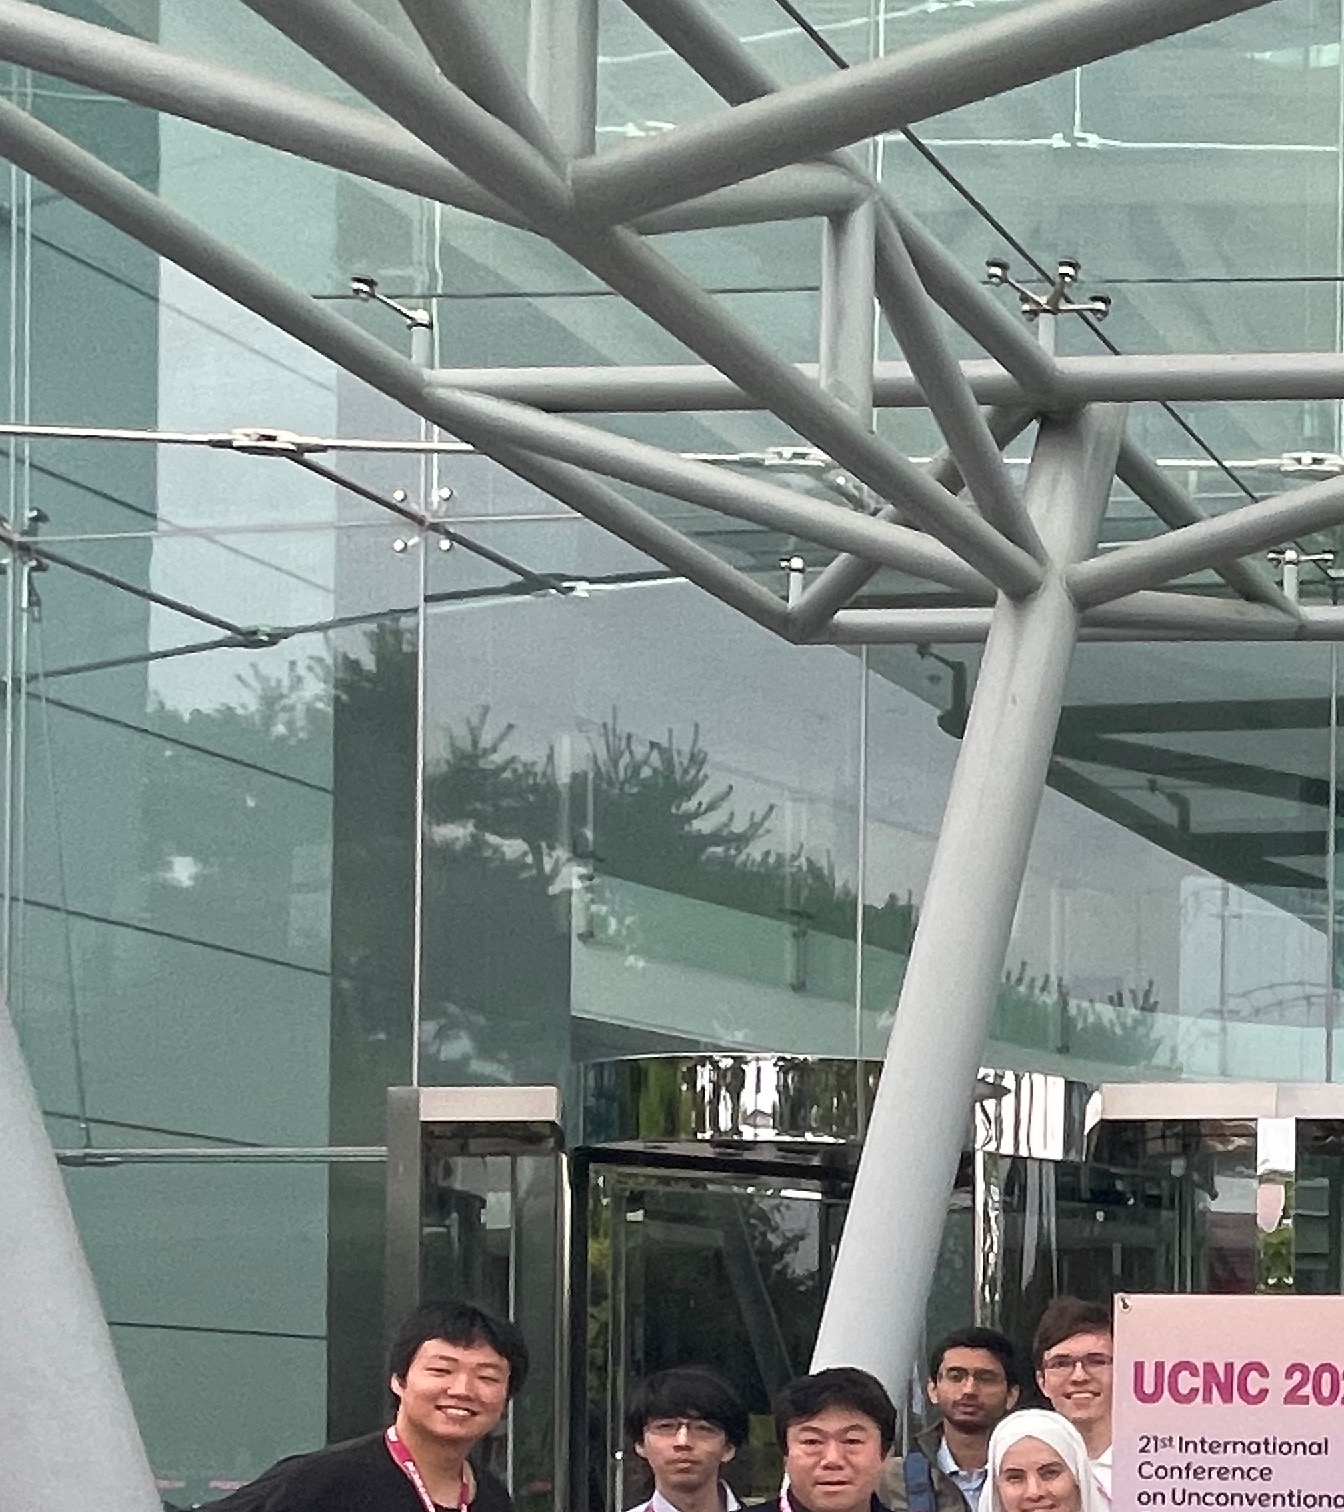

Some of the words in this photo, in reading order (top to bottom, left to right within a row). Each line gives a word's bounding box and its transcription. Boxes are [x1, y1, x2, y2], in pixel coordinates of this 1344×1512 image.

[1133, 1360, 1270, 1405] UCNC
[1138, 1435, 1174, 1453] 21st
[1178, 1436, 1329, 1456] International
[1137, 1460, 1273, 1481] Conference
[1137, 1490, 1166, 1506] on
